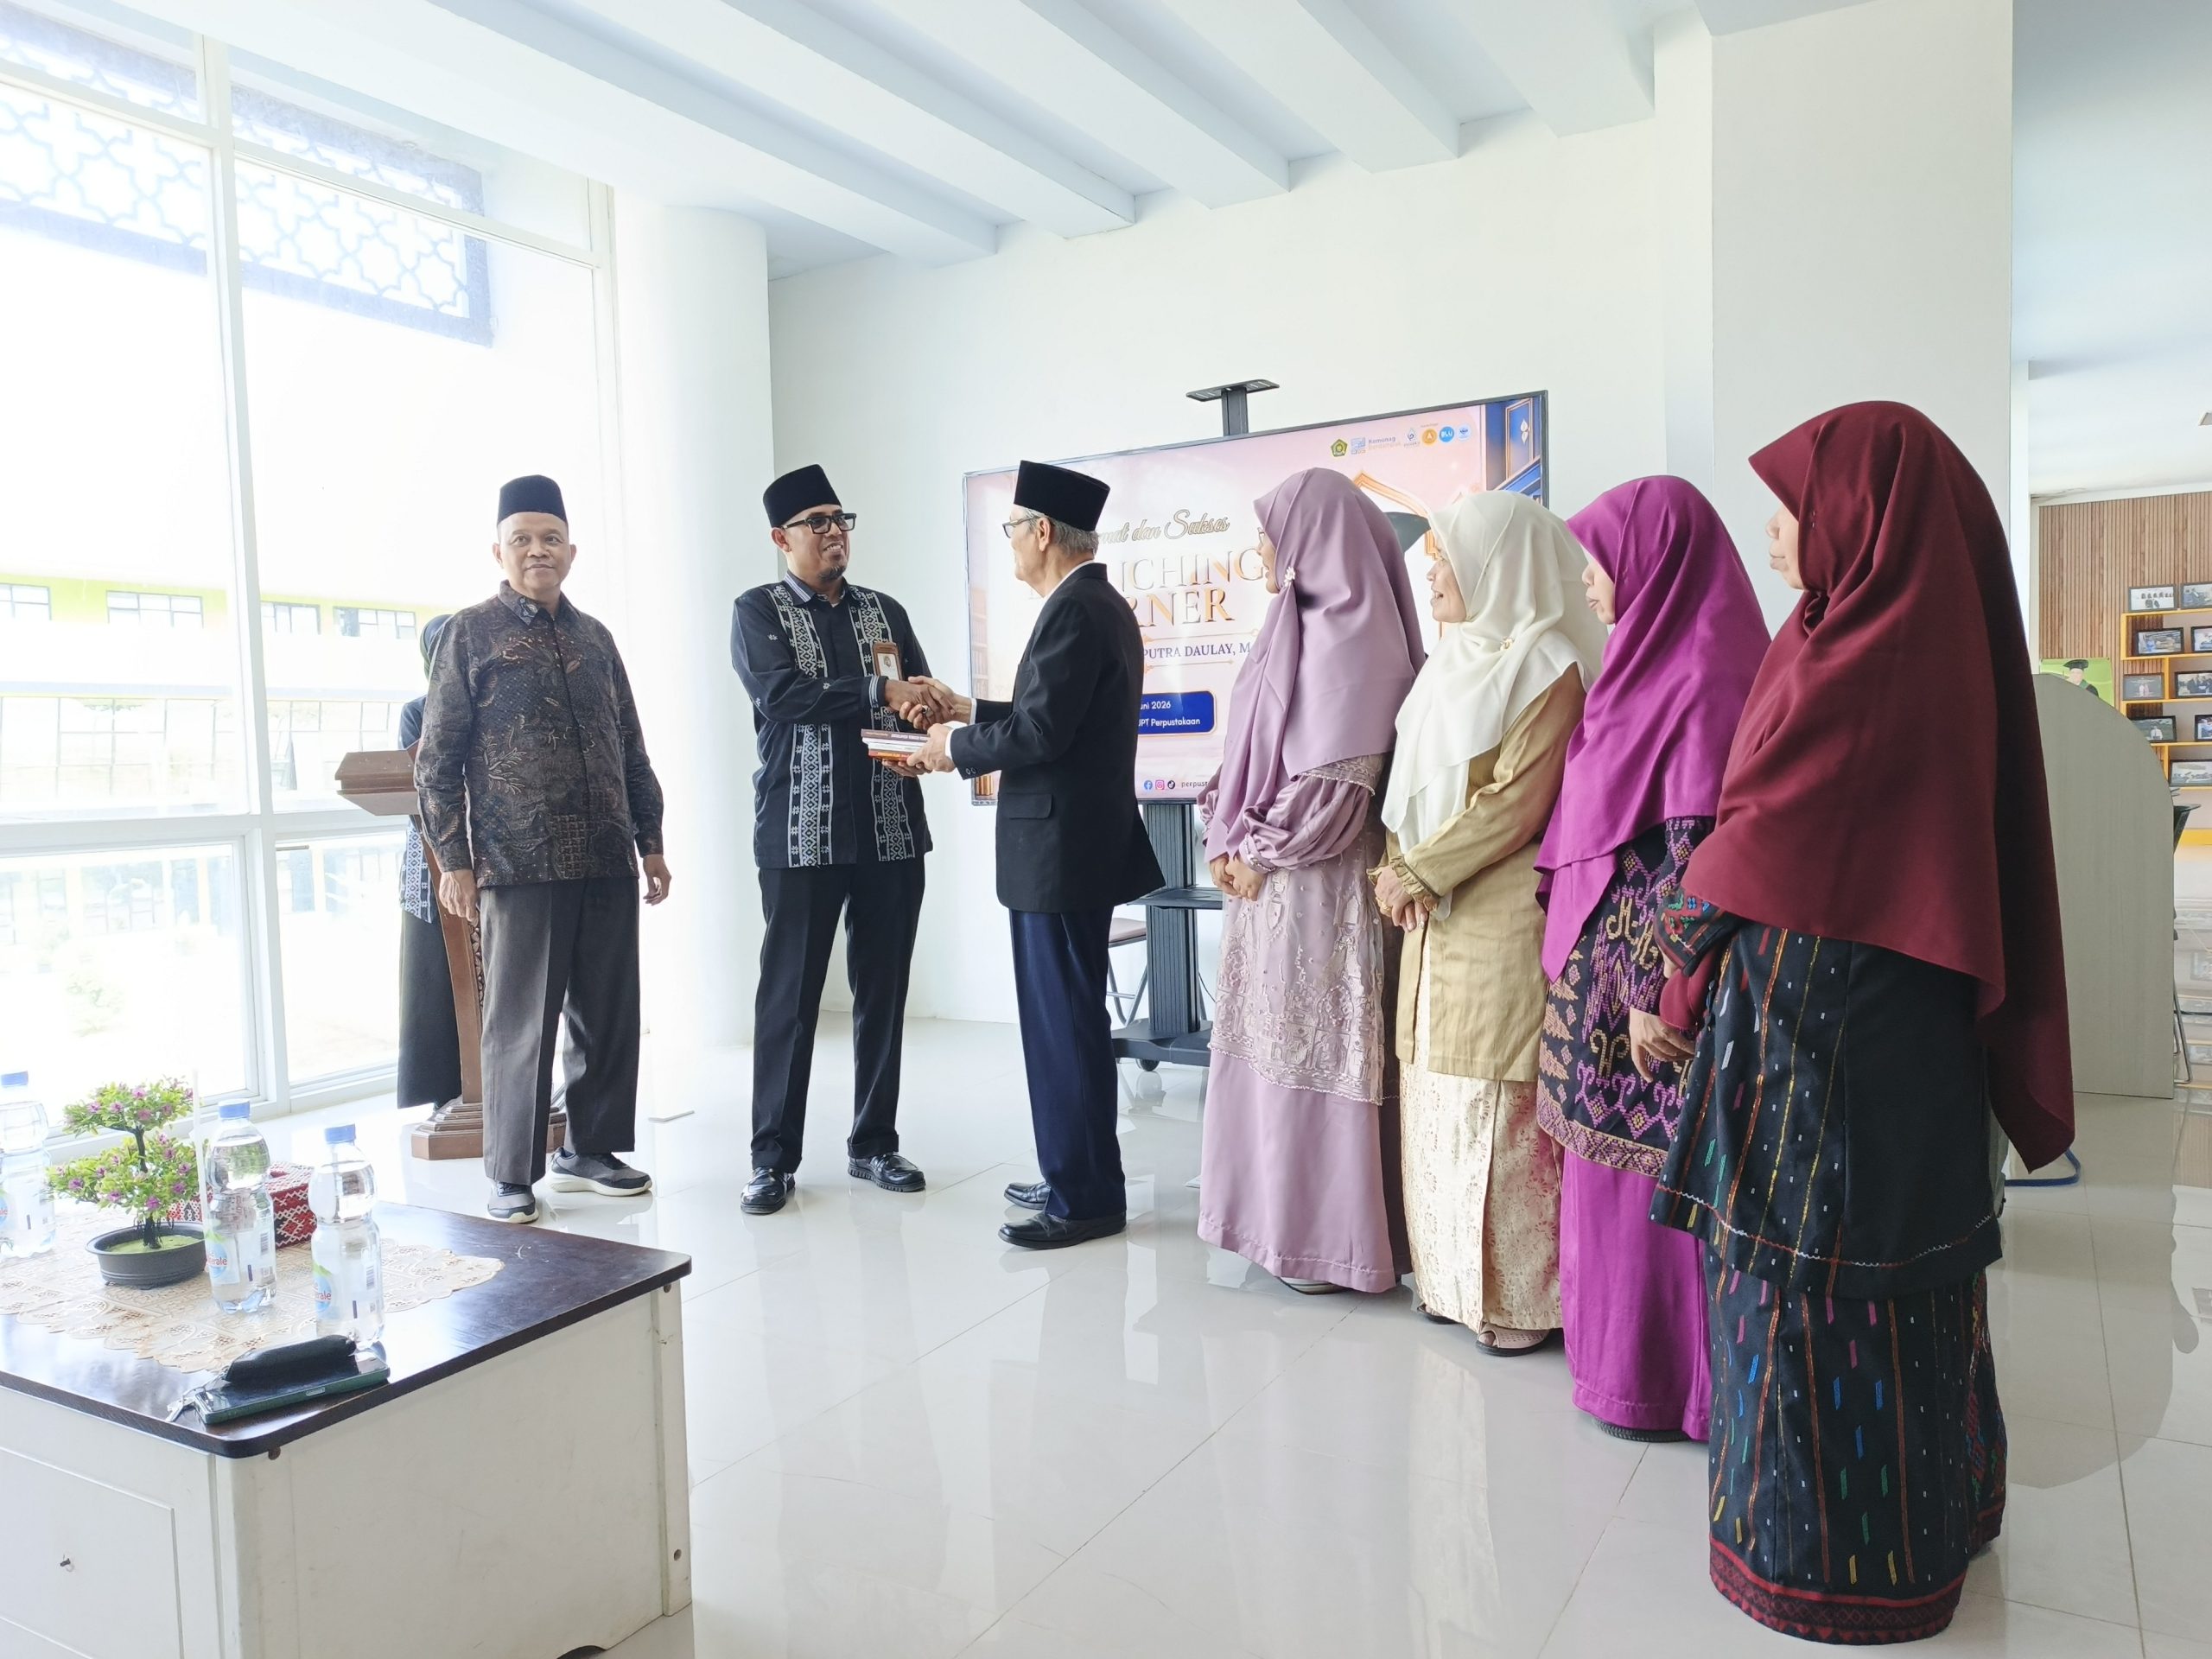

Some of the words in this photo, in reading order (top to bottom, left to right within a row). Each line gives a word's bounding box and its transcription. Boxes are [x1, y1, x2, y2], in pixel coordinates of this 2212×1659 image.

[1132, 519, 1161, 541] dan
[1164, 509, 1230, 539] Sukses
[1185, 643, 1236, 657] DAULAY,
[1151, 700, 1171, 709] 2026
[1150, 716, 1200, 729] Perpustakaan
